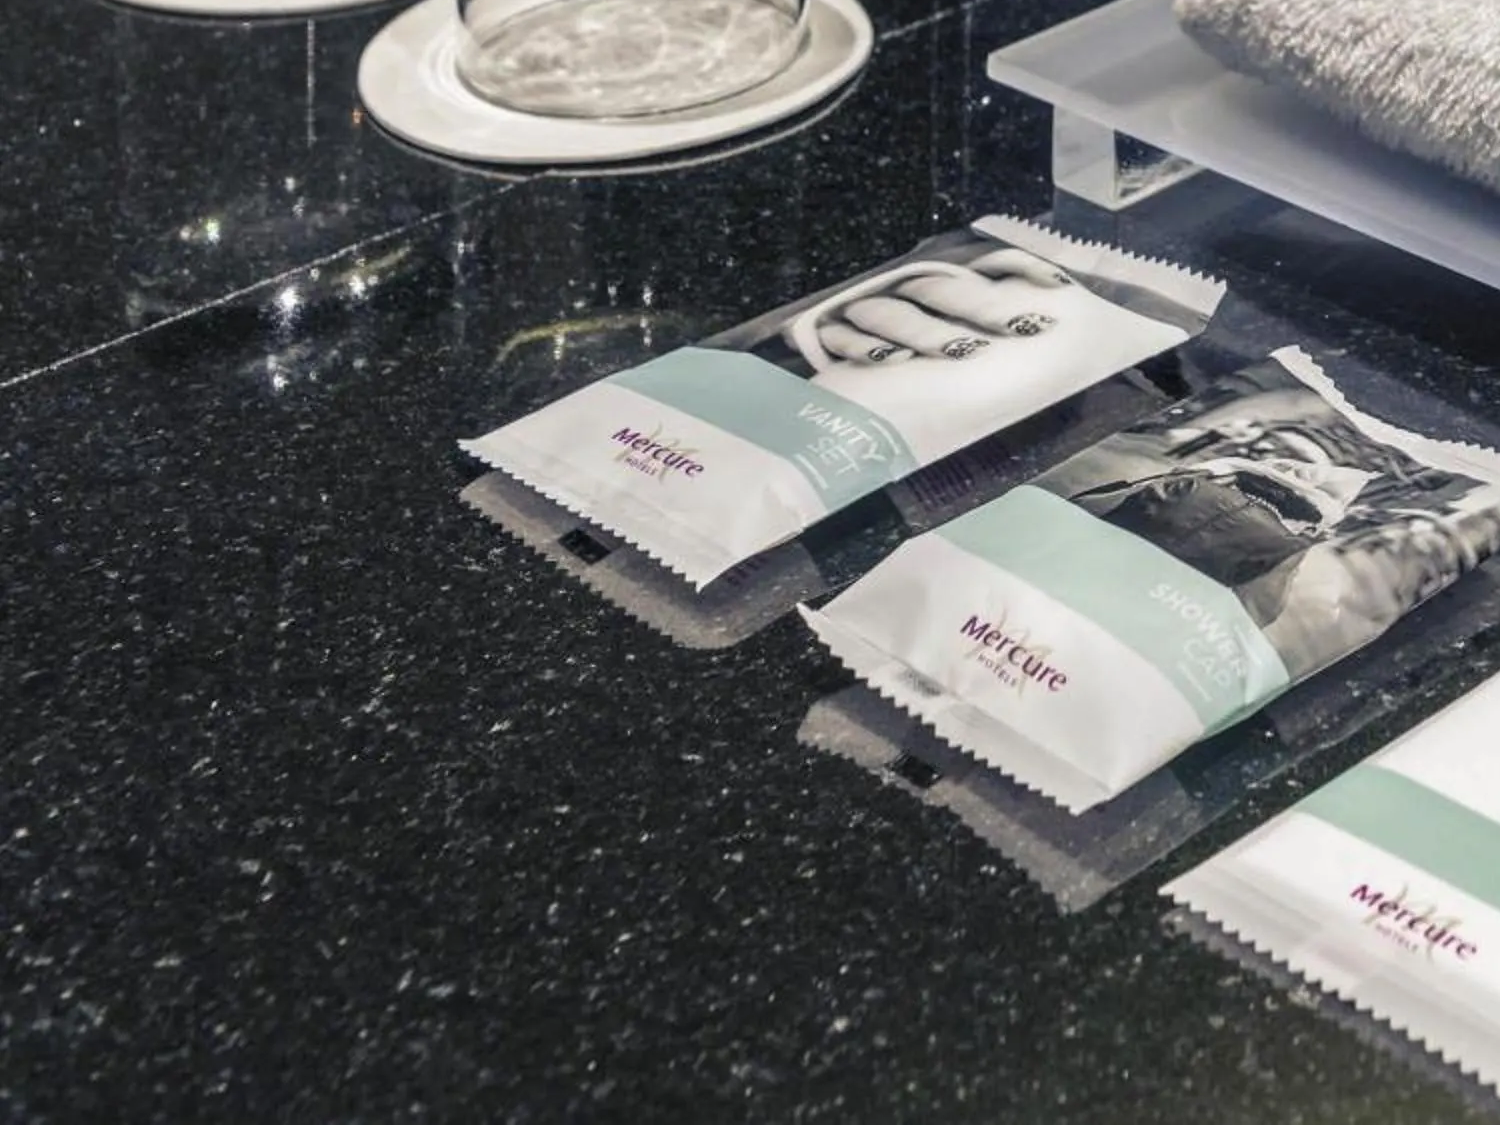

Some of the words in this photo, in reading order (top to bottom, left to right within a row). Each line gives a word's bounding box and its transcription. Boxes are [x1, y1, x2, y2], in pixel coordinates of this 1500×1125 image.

[611, 427, 704, 477] Mercure
[797, 402, 886, 462] VANITY
[960, 614, 1067, 692] Mercure
[1350, 883, 1478, 960] Mercure
